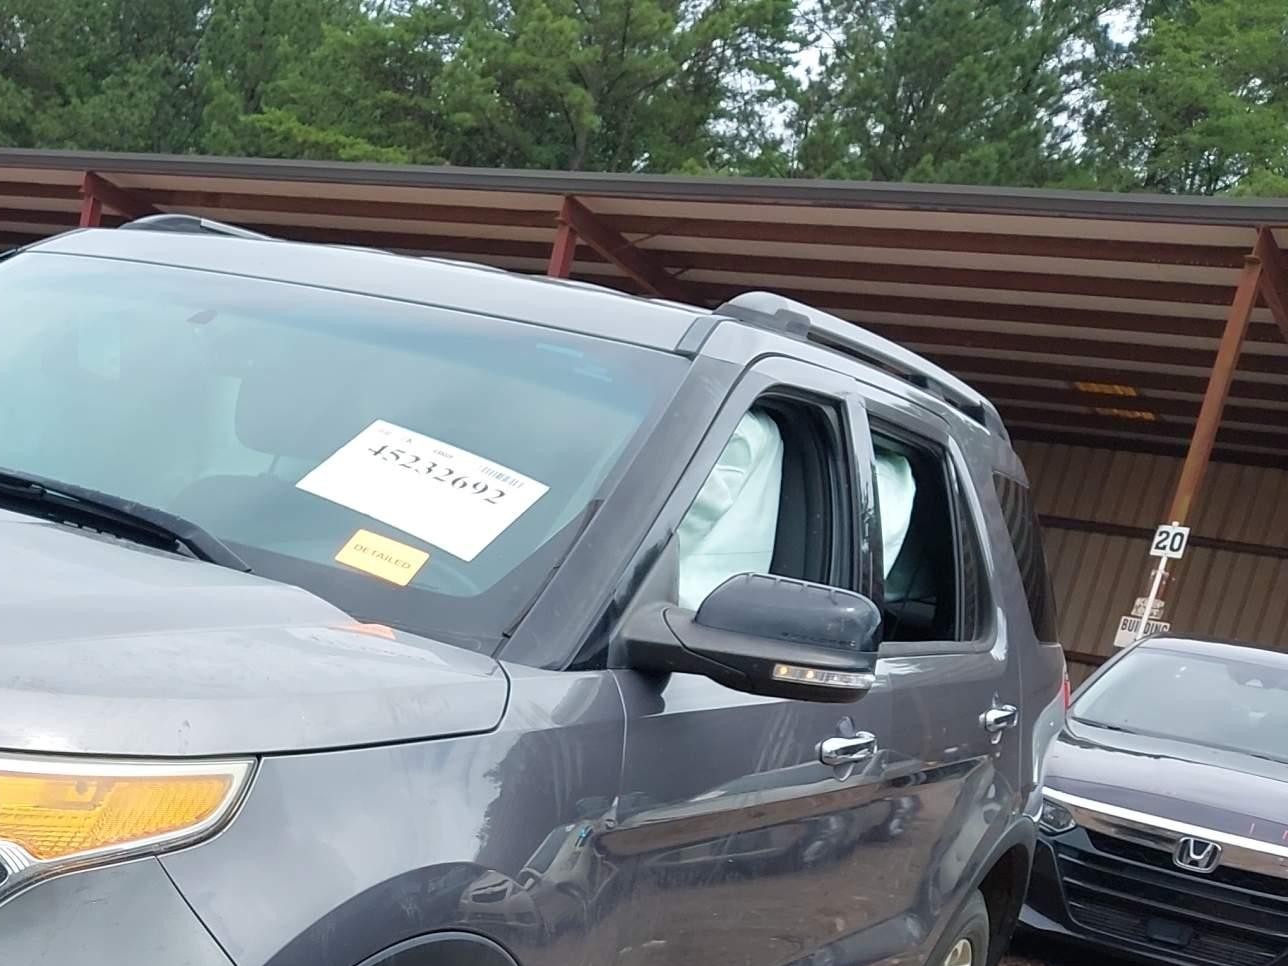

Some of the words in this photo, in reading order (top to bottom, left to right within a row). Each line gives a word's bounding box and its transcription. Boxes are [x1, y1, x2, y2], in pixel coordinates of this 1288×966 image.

[368, 445, 507, 505] 45232692
[1154, 530, 1185, 553] 20
[353, 543, 412, 569] DETAILED
[1121, 618, 1168, 635] BUIDING
